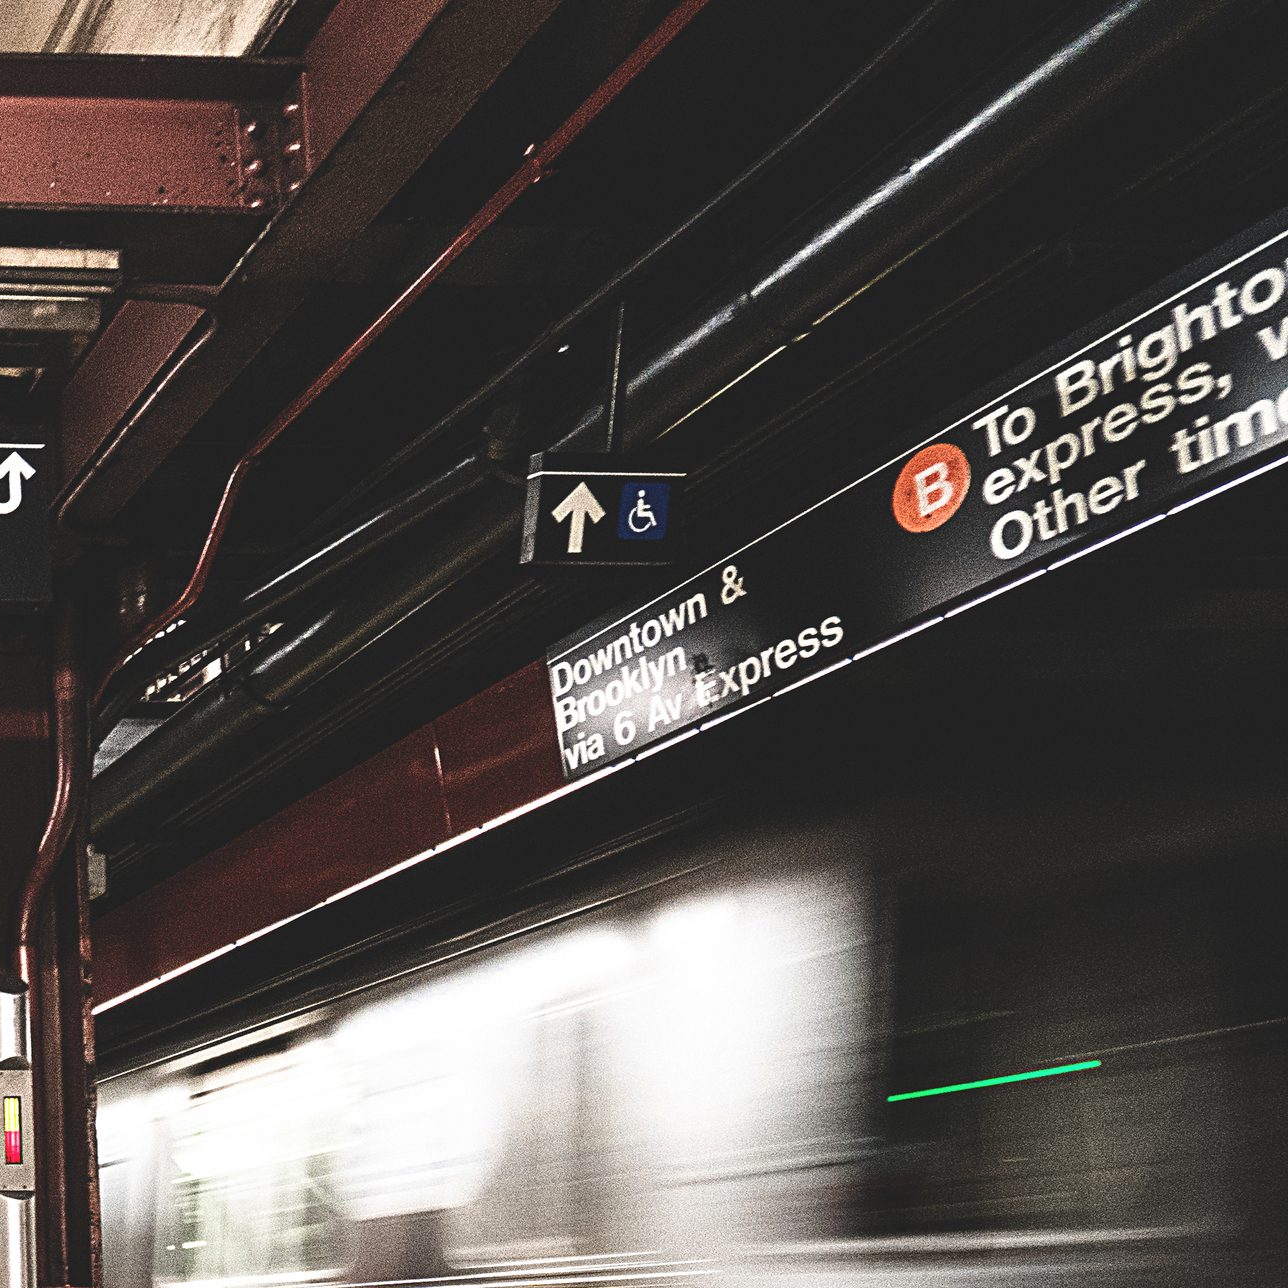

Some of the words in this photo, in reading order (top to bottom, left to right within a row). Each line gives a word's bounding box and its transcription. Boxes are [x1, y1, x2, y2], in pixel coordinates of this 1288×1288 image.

[971, 404, 1036, 459] To
[1054, 258, 1288, 418] Brighto
[913, 461, 953, 518] B
[981, 360, 1233, 505] express,
[989, 458, 1146, 561] Other
[1167, 386, 1288, 475] tim
[550, 592, 709, 697] Downtown
[721, 564, 748, 605] &
[555, 645, 688, 733] Brooklyn
[563, 728, 606, 770] via
[612, 709, 637, 746] 6
[647, 690, 684, 732] Av
[693, 614, 845, 709] Express
